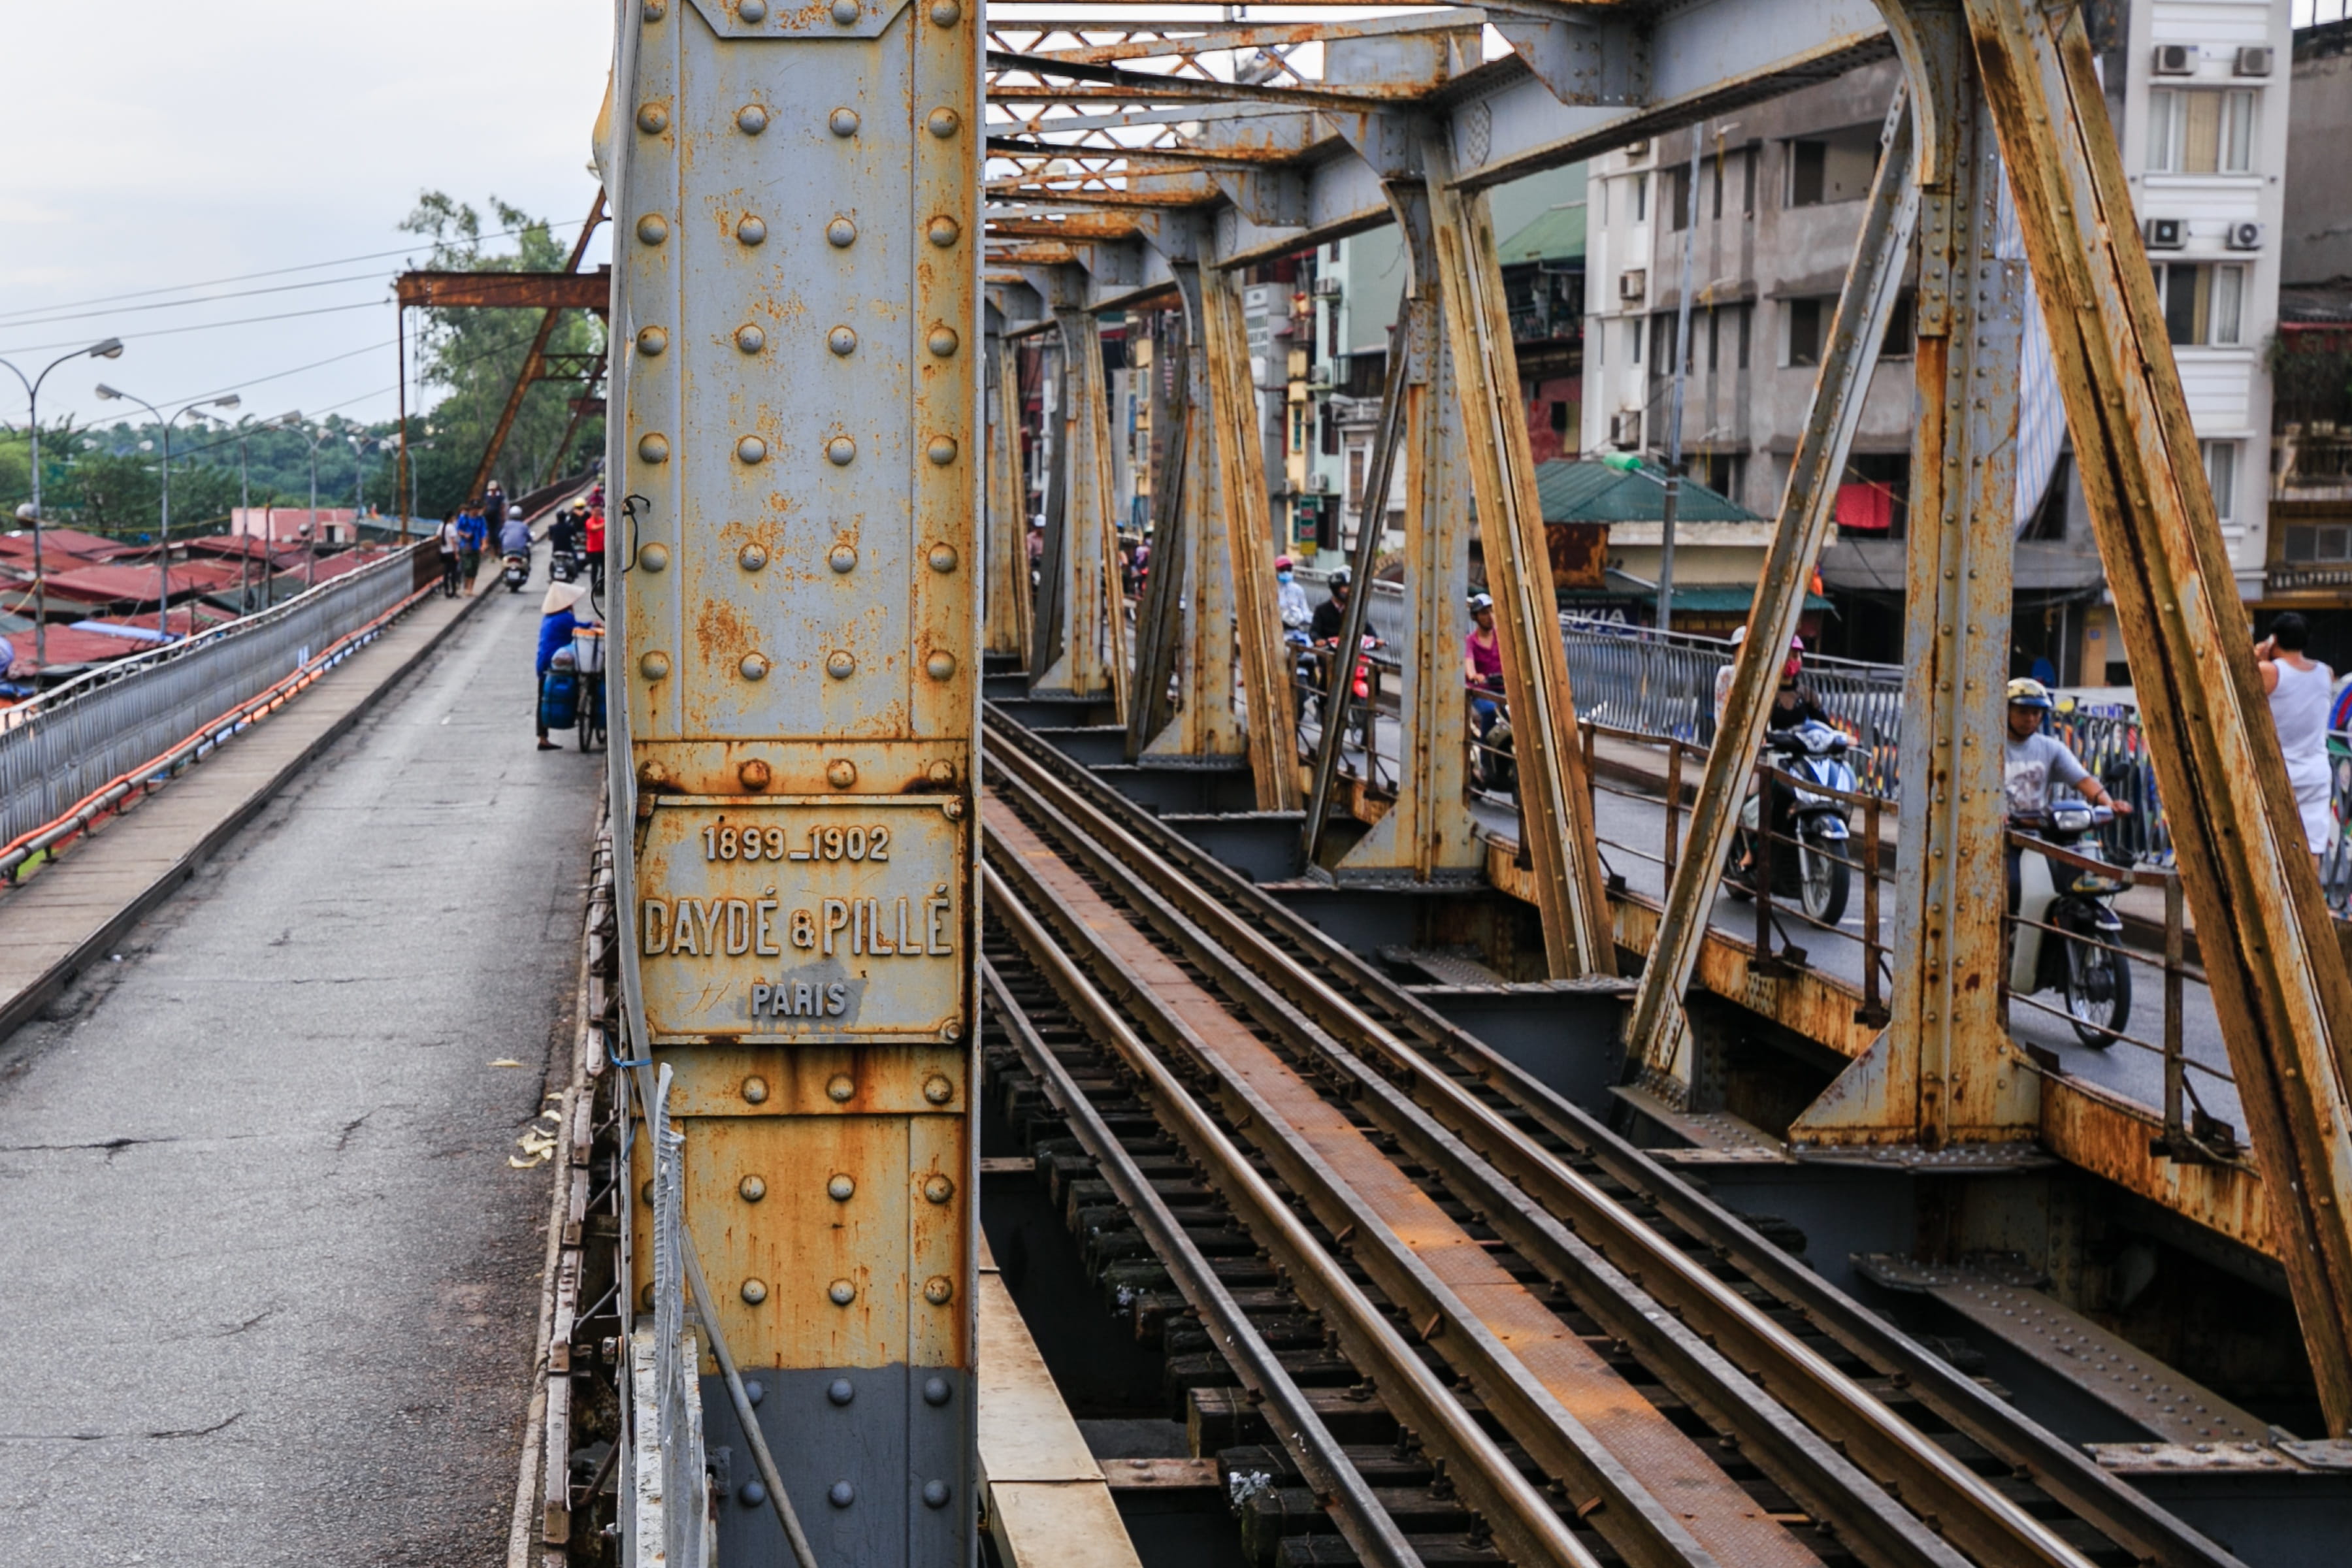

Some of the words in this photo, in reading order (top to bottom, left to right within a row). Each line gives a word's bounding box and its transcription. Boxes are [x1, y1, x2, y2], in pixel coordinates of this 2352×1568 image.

[644, 886, 780, 956] DAYDÉ
[791, 909, 815, 948] &
[823, 883, 953, 956] PILLÉ
[751, 983, 846, 1017] PARIS
